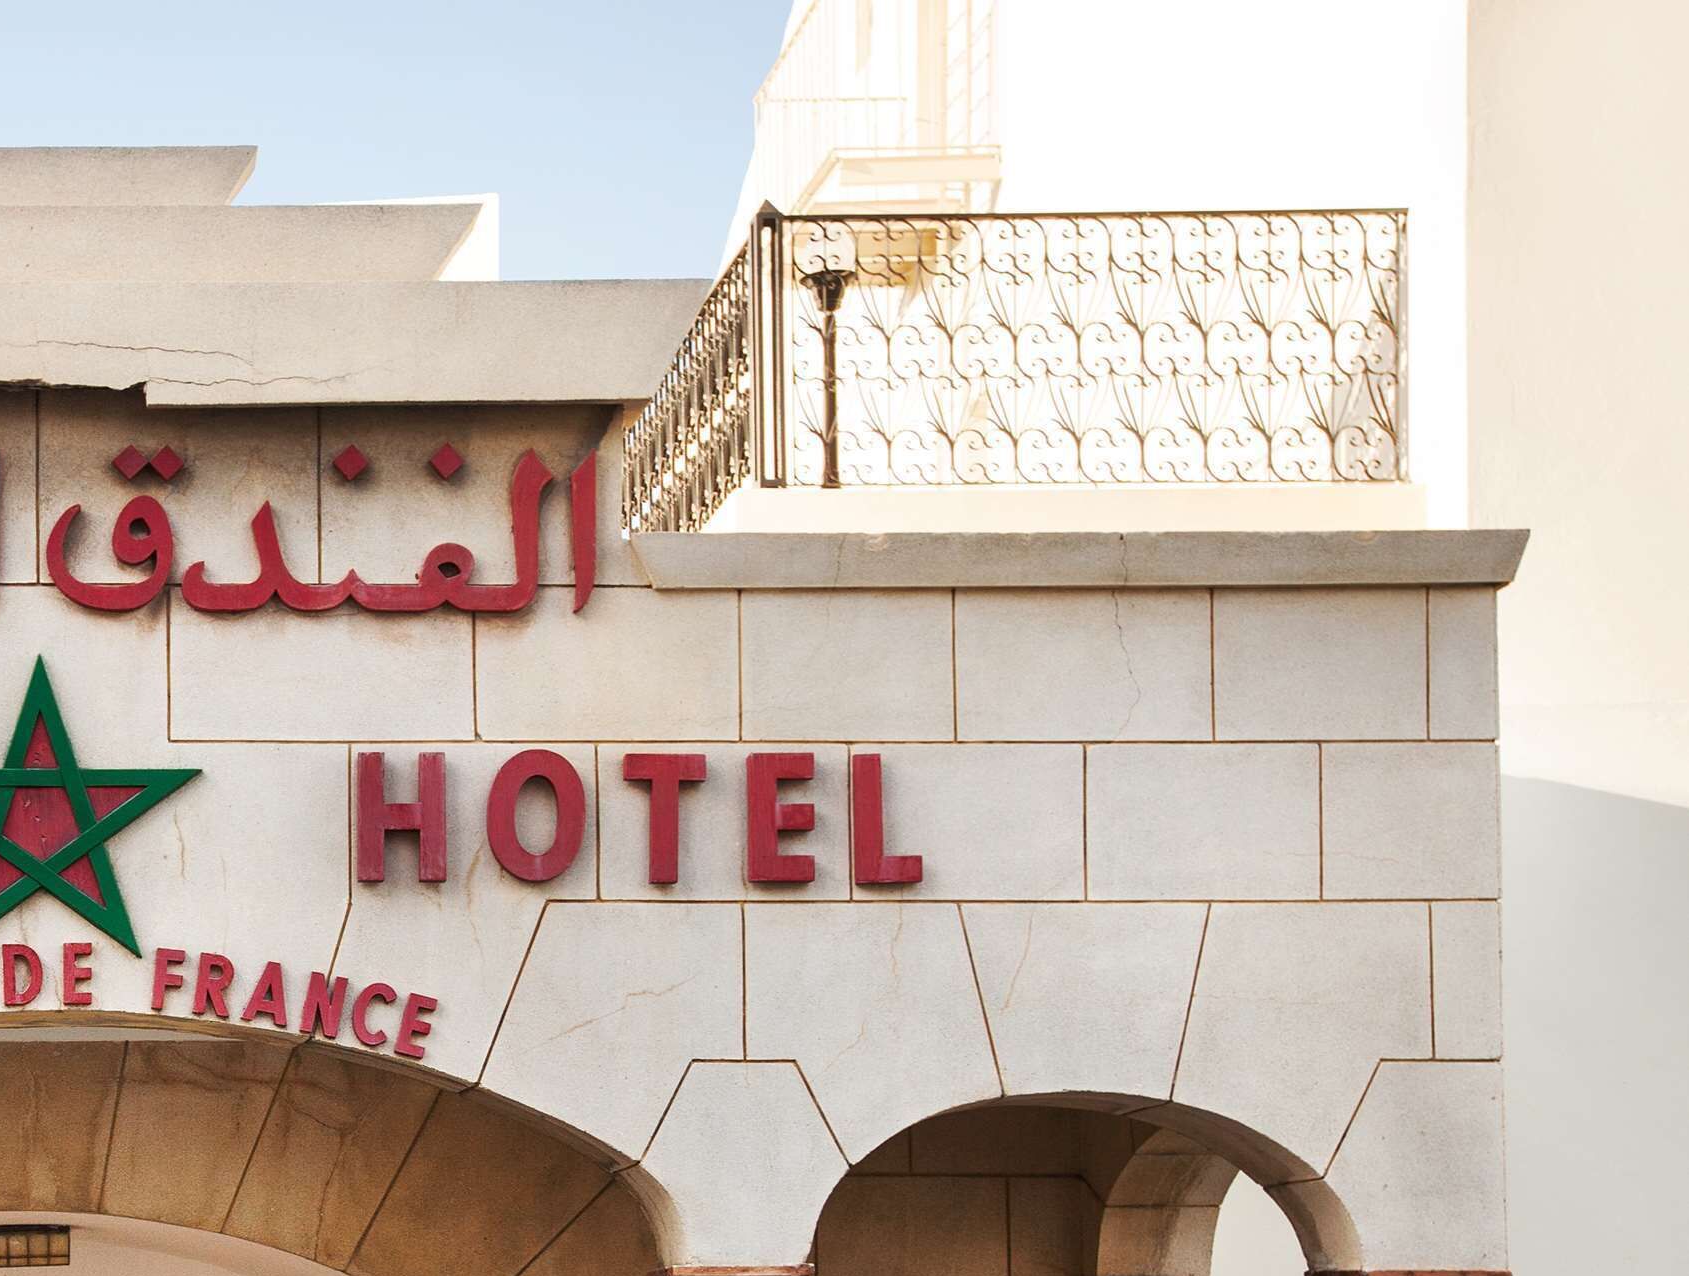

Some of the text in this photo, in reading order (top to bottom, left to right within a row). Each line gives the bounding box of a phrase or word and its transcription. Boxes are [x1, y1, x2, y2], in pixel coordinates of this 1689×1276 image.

[45, 443, 599, 615] الفندق
[356, 752, 923, 884] HOTEL
[0, 942, 95, 1008] DE
[151, 947, 439, 1060] FRANCE
